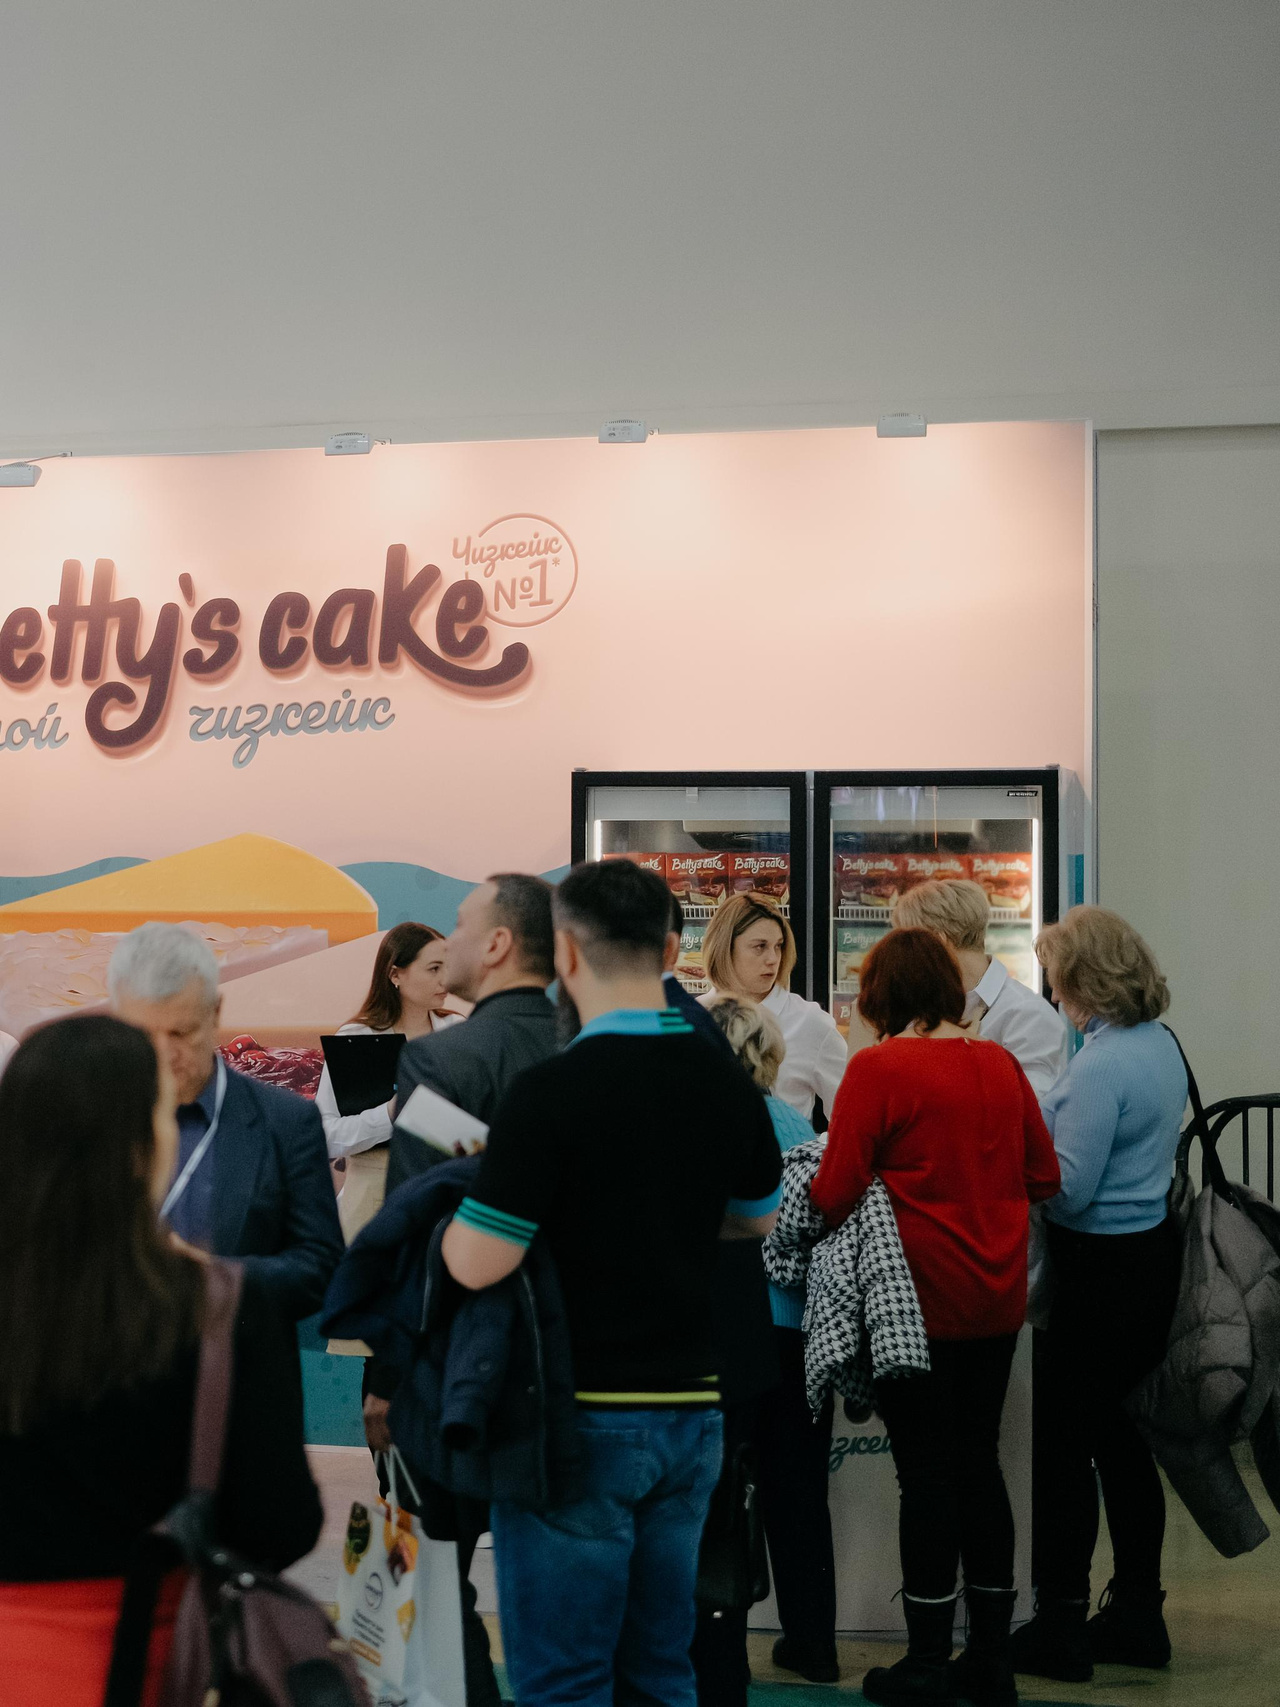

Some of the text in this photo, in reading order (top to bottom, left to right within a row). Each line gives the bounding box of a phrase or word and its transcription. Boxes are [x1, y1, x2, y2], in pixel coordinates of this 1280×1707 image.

[452, 531, 562, 578] Чизкейк
[258, 543, 531, 689] cake
[188, 688, 396, 769] чизкейк
